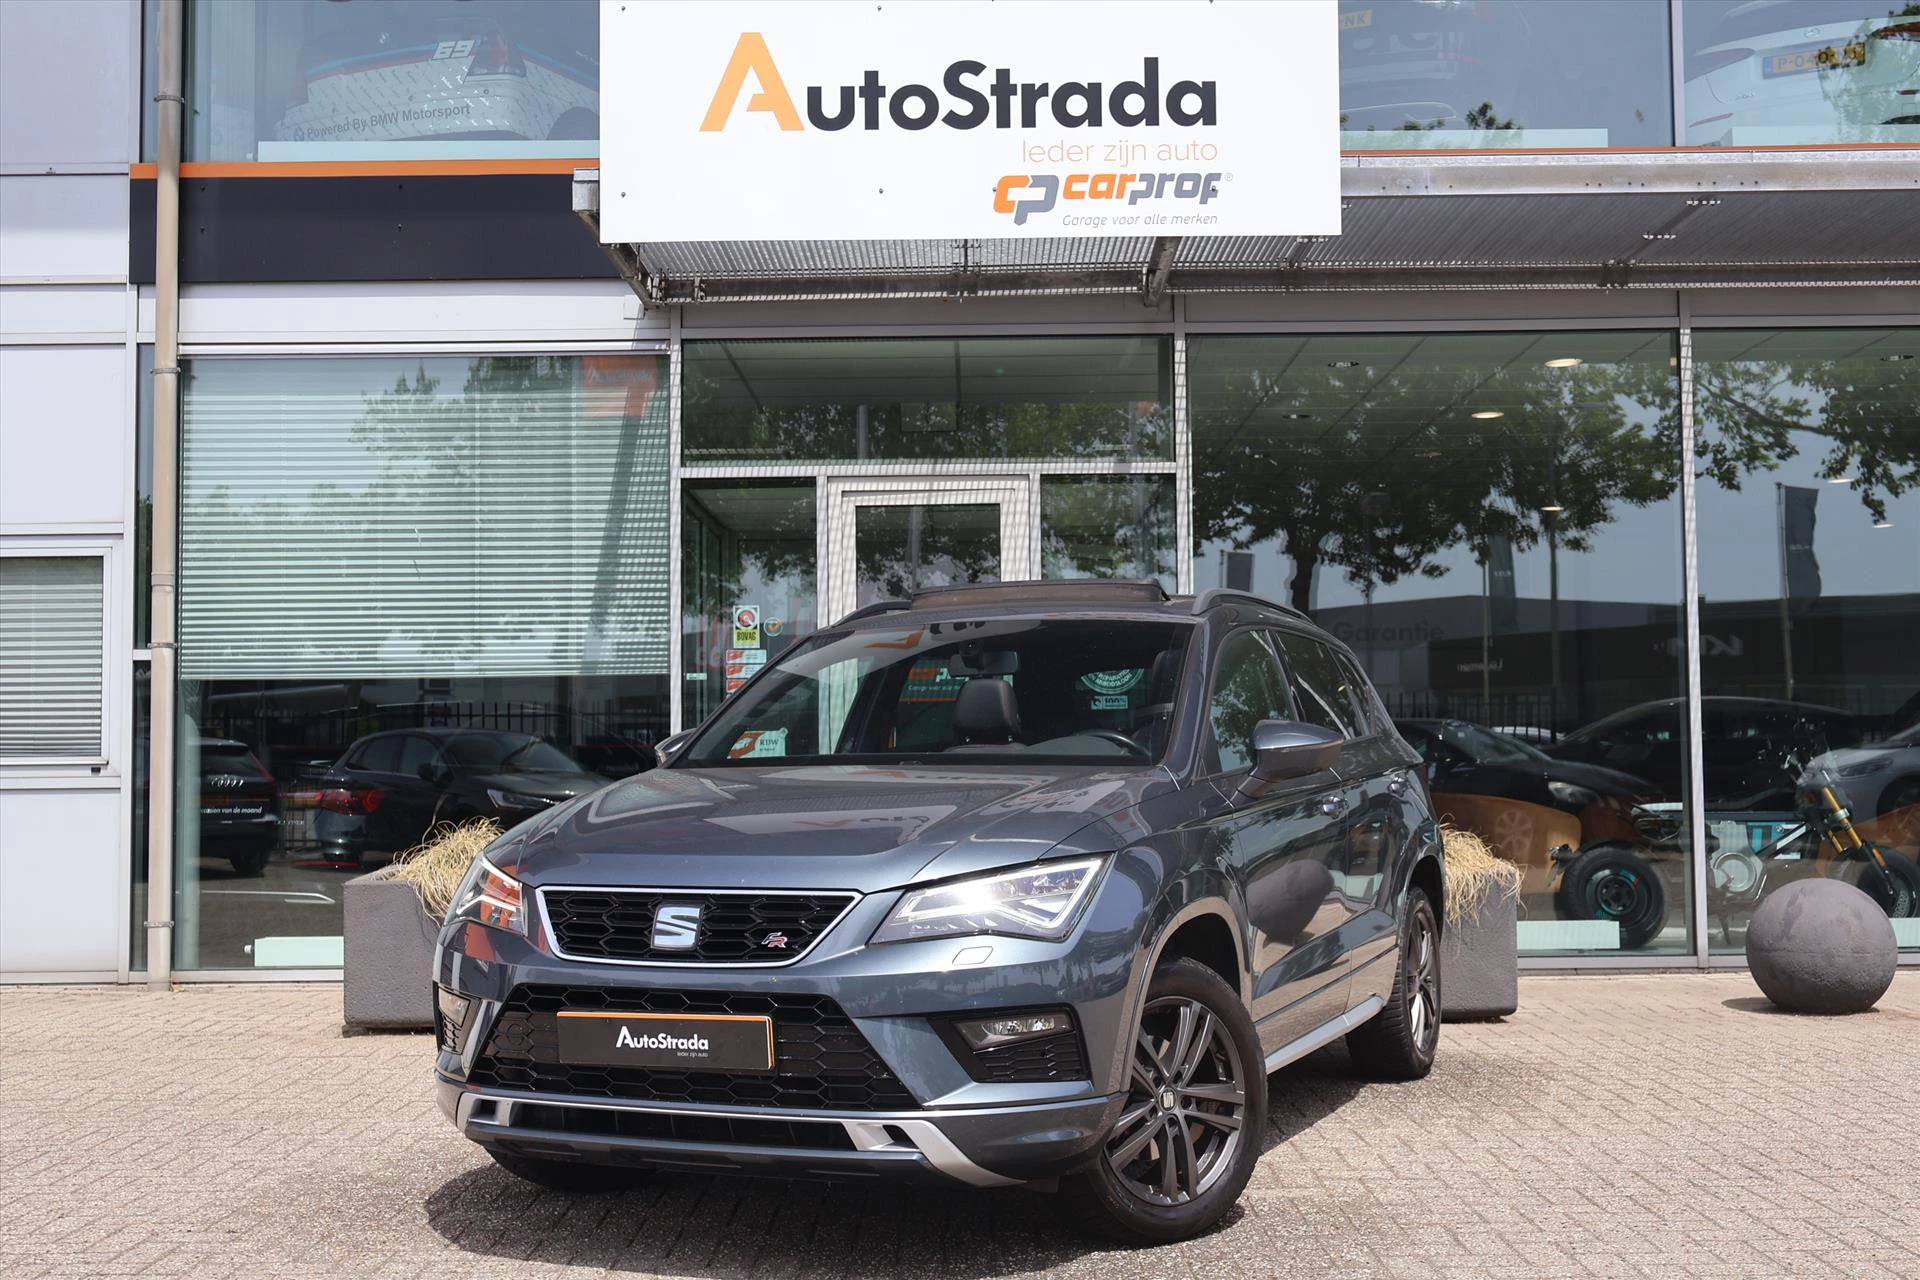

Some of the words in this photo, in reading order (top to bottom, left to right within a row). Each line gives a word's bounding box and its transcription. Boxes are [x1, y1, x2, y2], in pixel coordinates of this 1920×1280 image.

[432, 40, 475, 60] 69
[698, 31, 1217, 132] AutoStrada
[306, 119, 350, 138] Powered
[353, 117, 367, 132] By
[370, 112, 399, 127] BMW
[402, 103, 472, 122] Motorsport
[1022, 139, 1095, 163] Ieder
[1103, 139, 1147, 168] zijn
[1157, 140, 1218, 161] auto
[1062, 172, 1222, 206] carprof
[1062, 214, 1108, 228] Garage
[1112, 216, 1141, 226] voor
[1144, 214, 1168, 225] alle
[1171, 214, 1218, 225] merken
[736, 631, 757, 641] BOVAG
[1332, 619, 1445, 642] Garantie
[759, 738, 779, 746] RDW
[616, 1025, 709, 1050] AutoStrada
